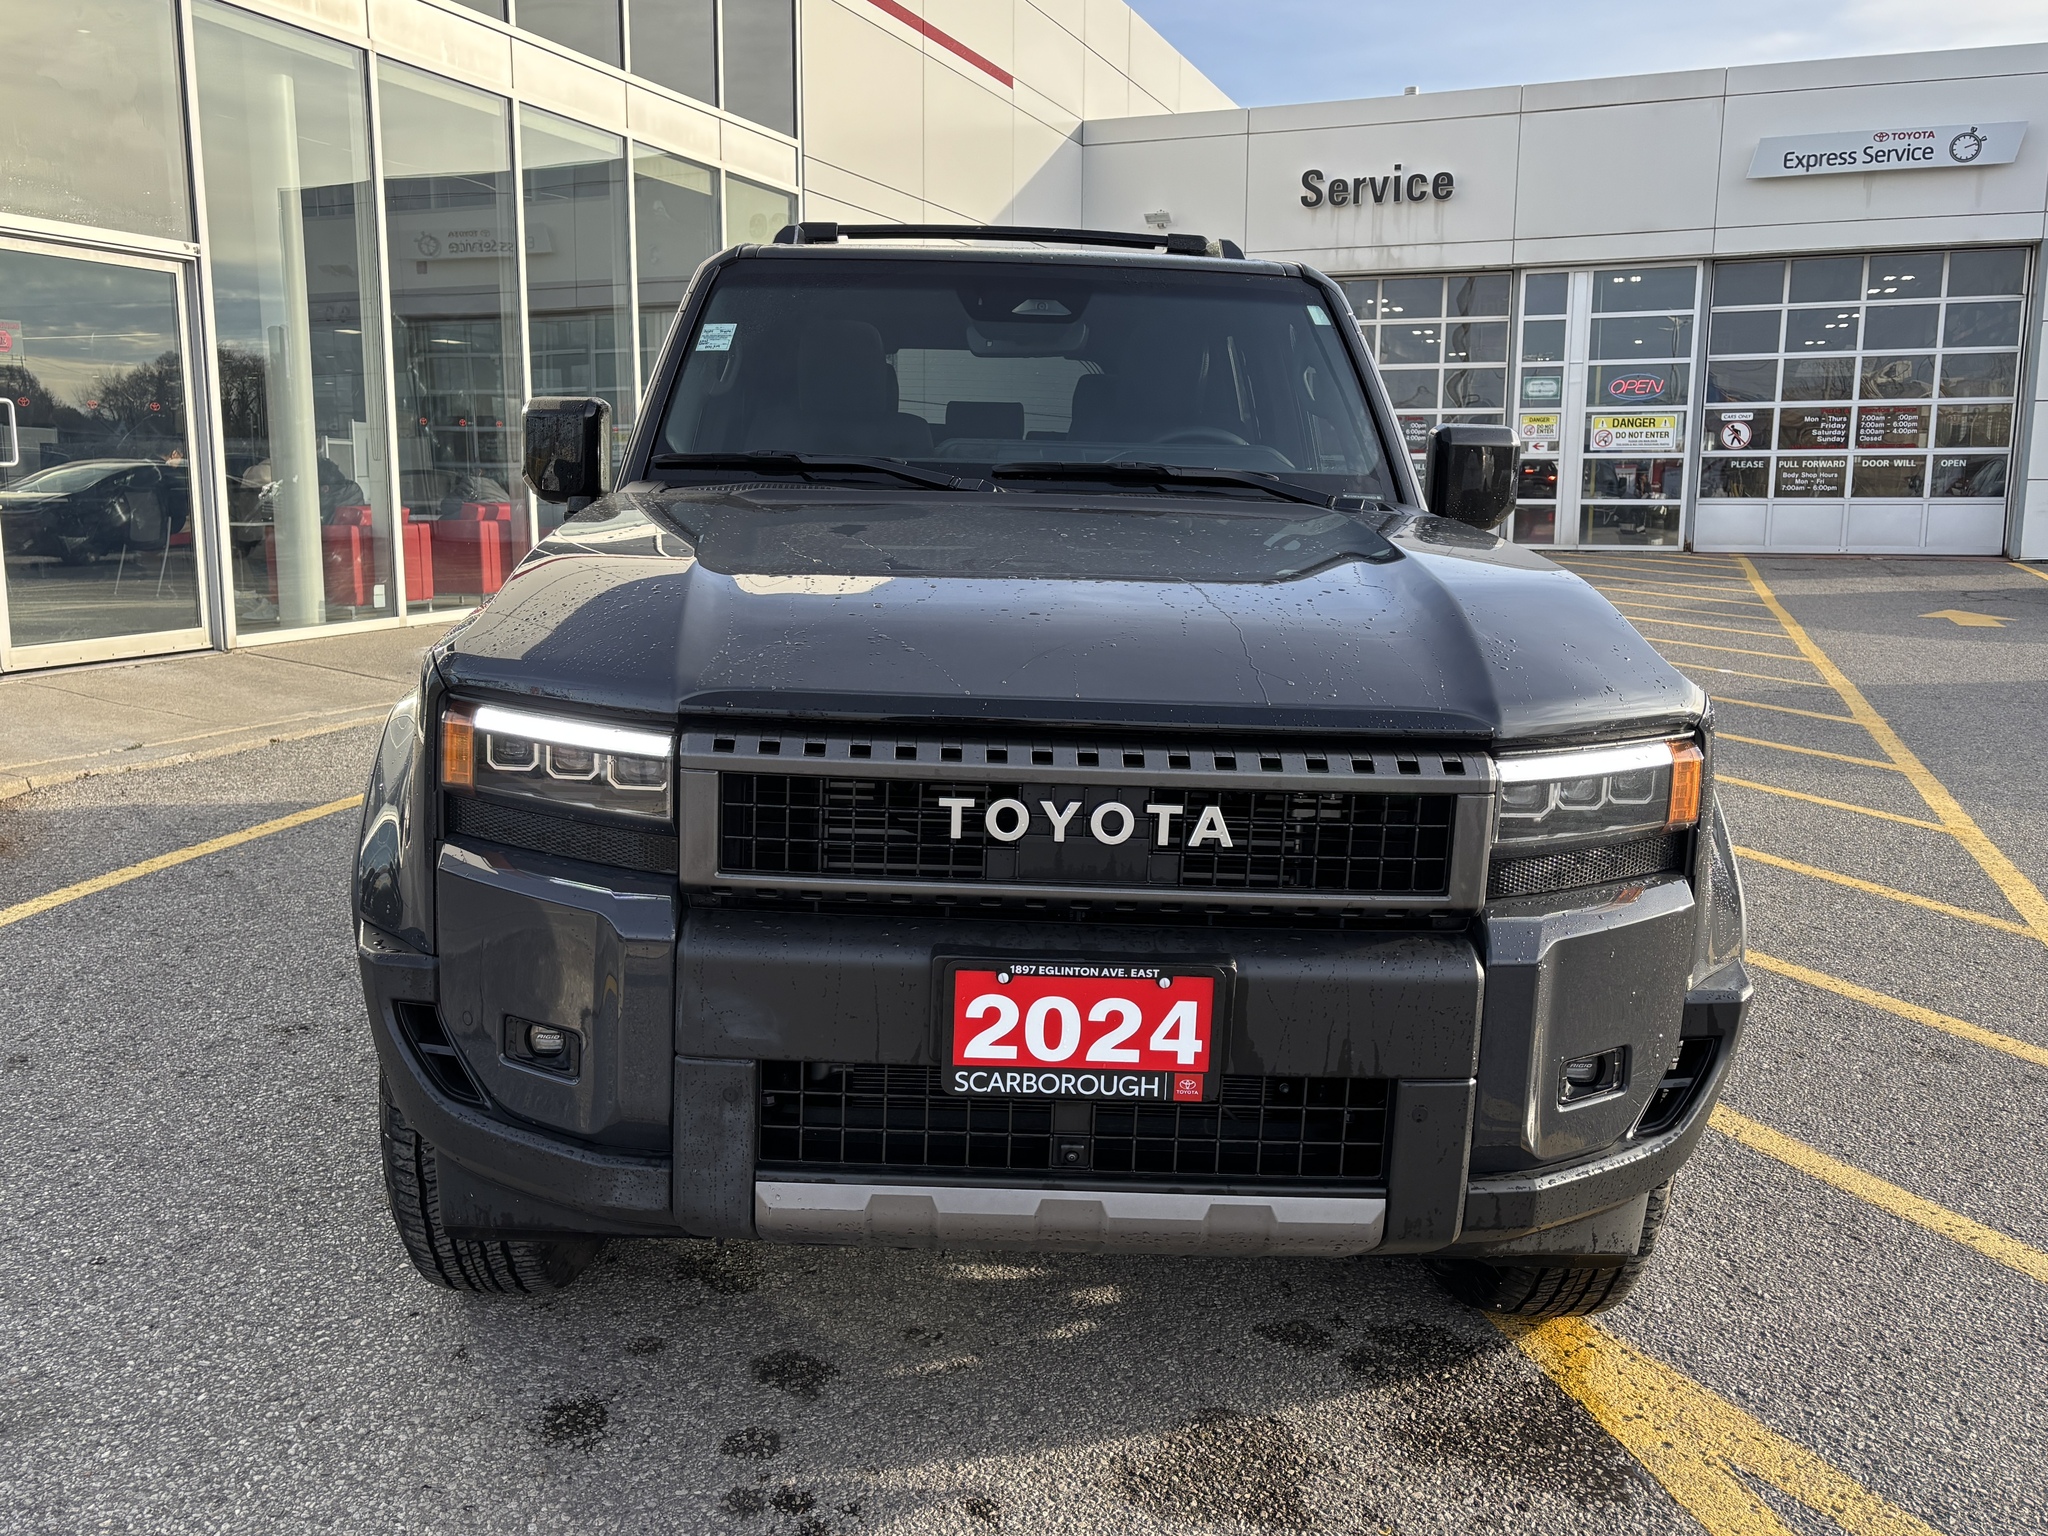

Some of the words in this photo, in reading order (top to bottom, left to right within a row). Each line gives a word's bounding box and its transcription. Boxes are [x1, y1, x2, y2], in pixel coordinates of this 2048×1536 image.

[1891, 130, 1936, 142] TOYOTA
[1783, 149, 1857, 172] Express
[1862, 144, 1935, 165] Service
[1300, 163, 1455, 208] Service
[1610, 379, 1665, 394] OPEN
[1612, 417, 1656, 428] DANGER
[1820, 422, 1846, 430] Friday
[1615, 431, 1627, 439] DO
[1628, 431, 1644, 439] NOT
[1645, 431, 1670, 439] ENTER
[1811, 429, 1846, 437] Saturday
[1730, 460, 1765, 468] PLEASE
[1778, 460, 1799, 468] PULL
[1802, 460, 1846, 468] FORWARD
[1861, 459, 1890, 467] DOOR
[1893, 459, 1917, 467] WILL
[1940, 459, 1967, 467] OPEN
[938, 797, 1234, 848] TOYOTA
[1009, 965, 1036, 975] 1897
[1038, 966, 1099, 977] EGLINTON
[1101, 968, 1128, 977] AVE.
[1131, 968, 1160, 978] EAST
[963, 993, 1203, 1065] 2024
[954, 1071, 1159, 1097] SCARBOROUGH
